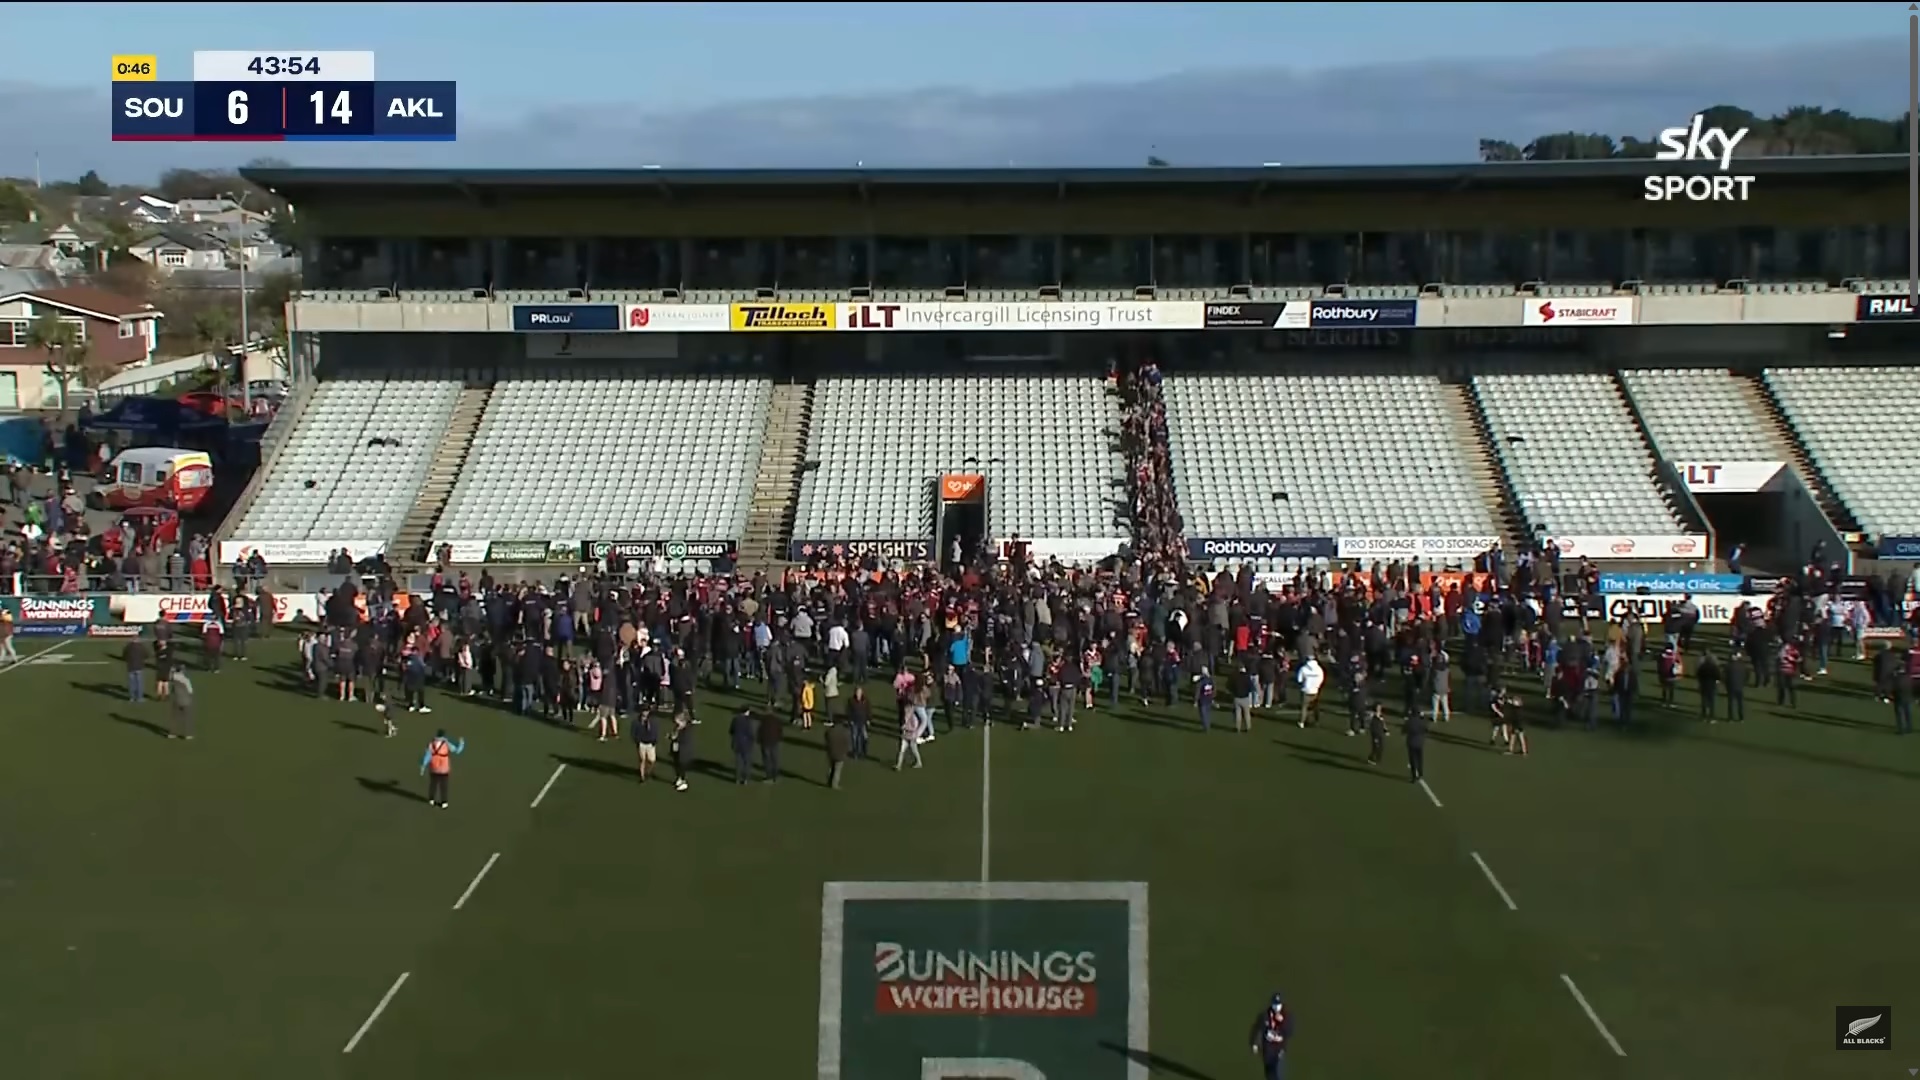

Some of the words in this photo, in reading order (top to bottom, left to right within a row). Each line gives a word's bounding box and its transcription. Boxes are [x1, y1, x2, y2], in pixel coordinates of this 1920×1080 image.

[1208, 306, 1240, 316] FINDEX
[1558, 308, 1617, 317] STABICRAFT
[1869, 299, 1914, 313] RML
[740, 307, 825, 326] Tulloch
[905, 306, 1010, 326] Invercargill
[1017, 306, 1101, 326] Licensing
[1108, 306, 1153, 322] Trust
[1313, 307, 1378, 321] Rothbury
[616, 545, 652, 555] MEDIA
[669, 545, 685, 555] GO
[688, 545, 724, 555] MEDIA
[849, 542, 928, 557] SPEIGHT'S
[1204, 541, 1276, 556] Rothbury
[1344, 539, 1366, 549] PRO
[1368, 539, 1416, 549] STORAGE
[1422, 539, 1444, 549] PRO
[1446, 538, 1494, 549] STORAGE
[1602, 579, 1625, 589] The
[1627, 579, 1685, 589] Headache
[1687, 579, 1721, 589] Clinic
[22, 598, 95, 610] BUNNINGS
[26, 609, 90, 619] warehouse
[1702, 605, 1728, 618] lift
[875, 942, 1097, 983] BUNNINGS
[889, 975, 1085, 1011] warehouse
